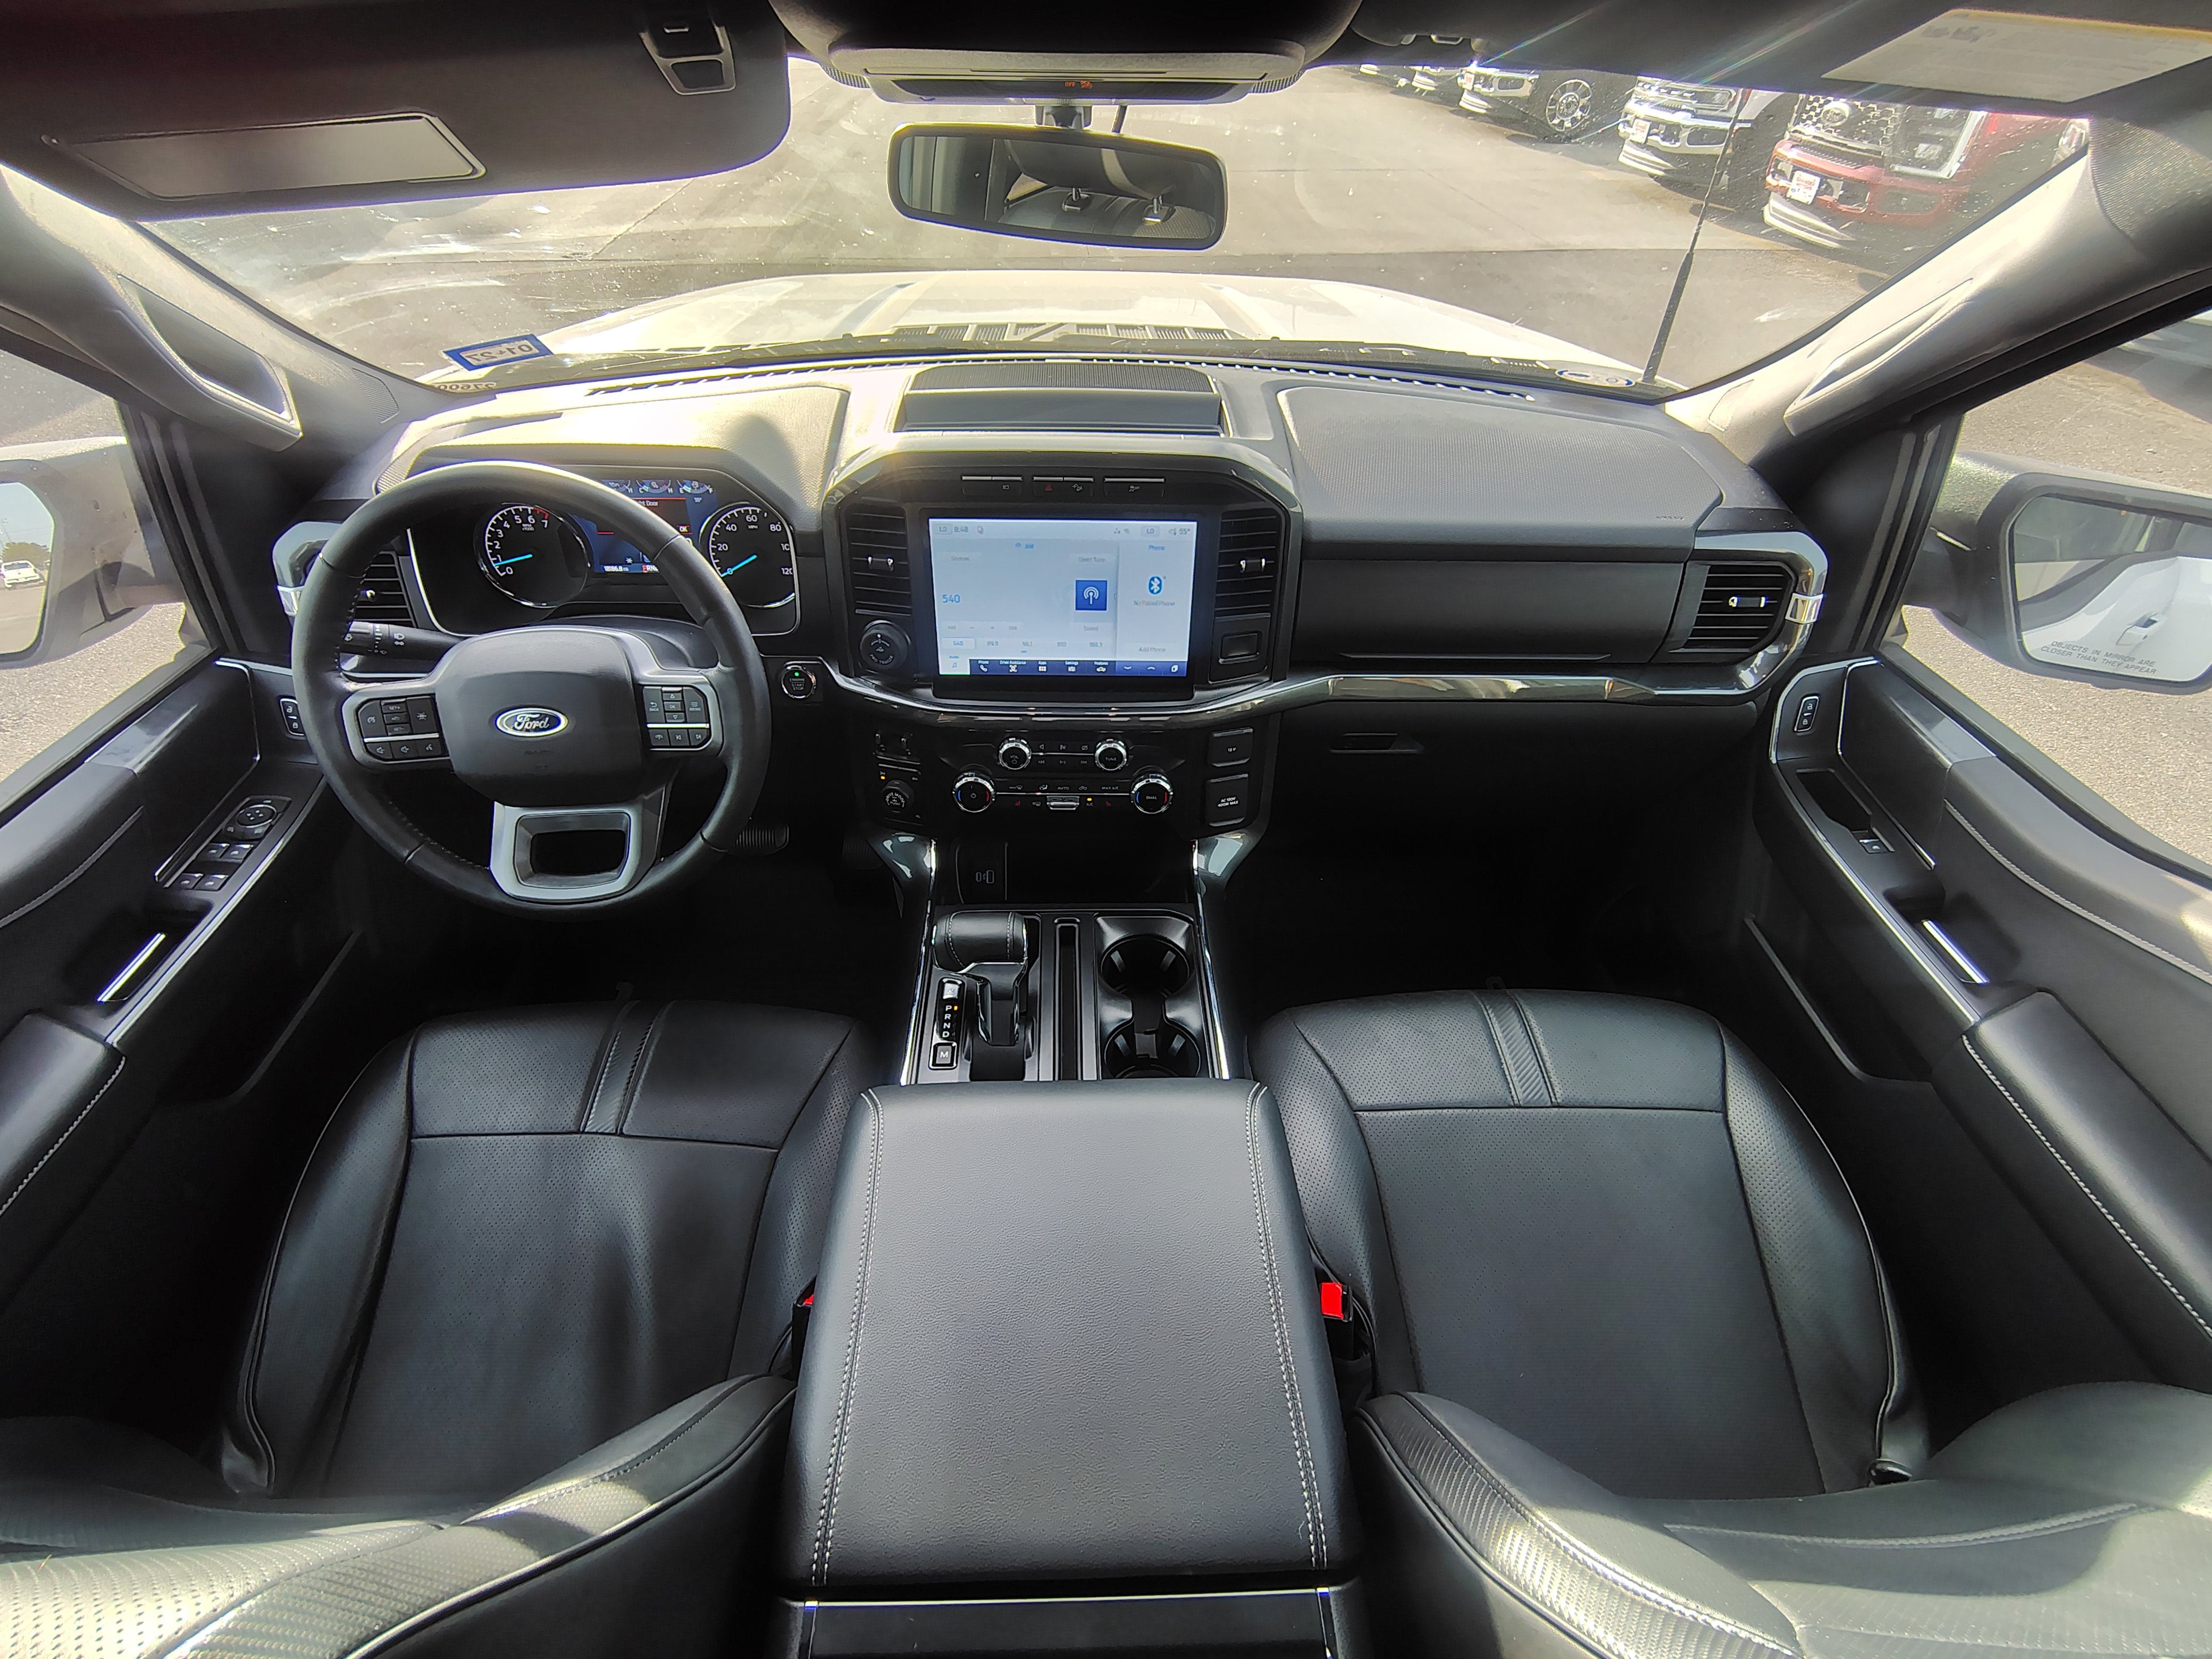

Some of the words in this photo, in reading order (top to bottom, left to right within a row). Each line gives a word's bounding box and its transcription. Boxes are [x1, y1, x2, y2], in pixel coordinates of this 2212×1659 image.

[514, 515, 522, 524] 5
[527, 515, 535, 524] 6
[542, 520, 548, 528] 7
[942, 594, 961, 604] 540
[2051, 640, 2089, 653] OBJECTS
[2104, 651, 2136, 663] MIRROR
[2041, 646, 2073, 657] CLOSER
[2076, 652, 2098, 663] THAN
[2101, 658, 2123, 668] THEY
[2123, 664, 2157, 675] APPEAR
[514, 714, 550, 730] Ford
